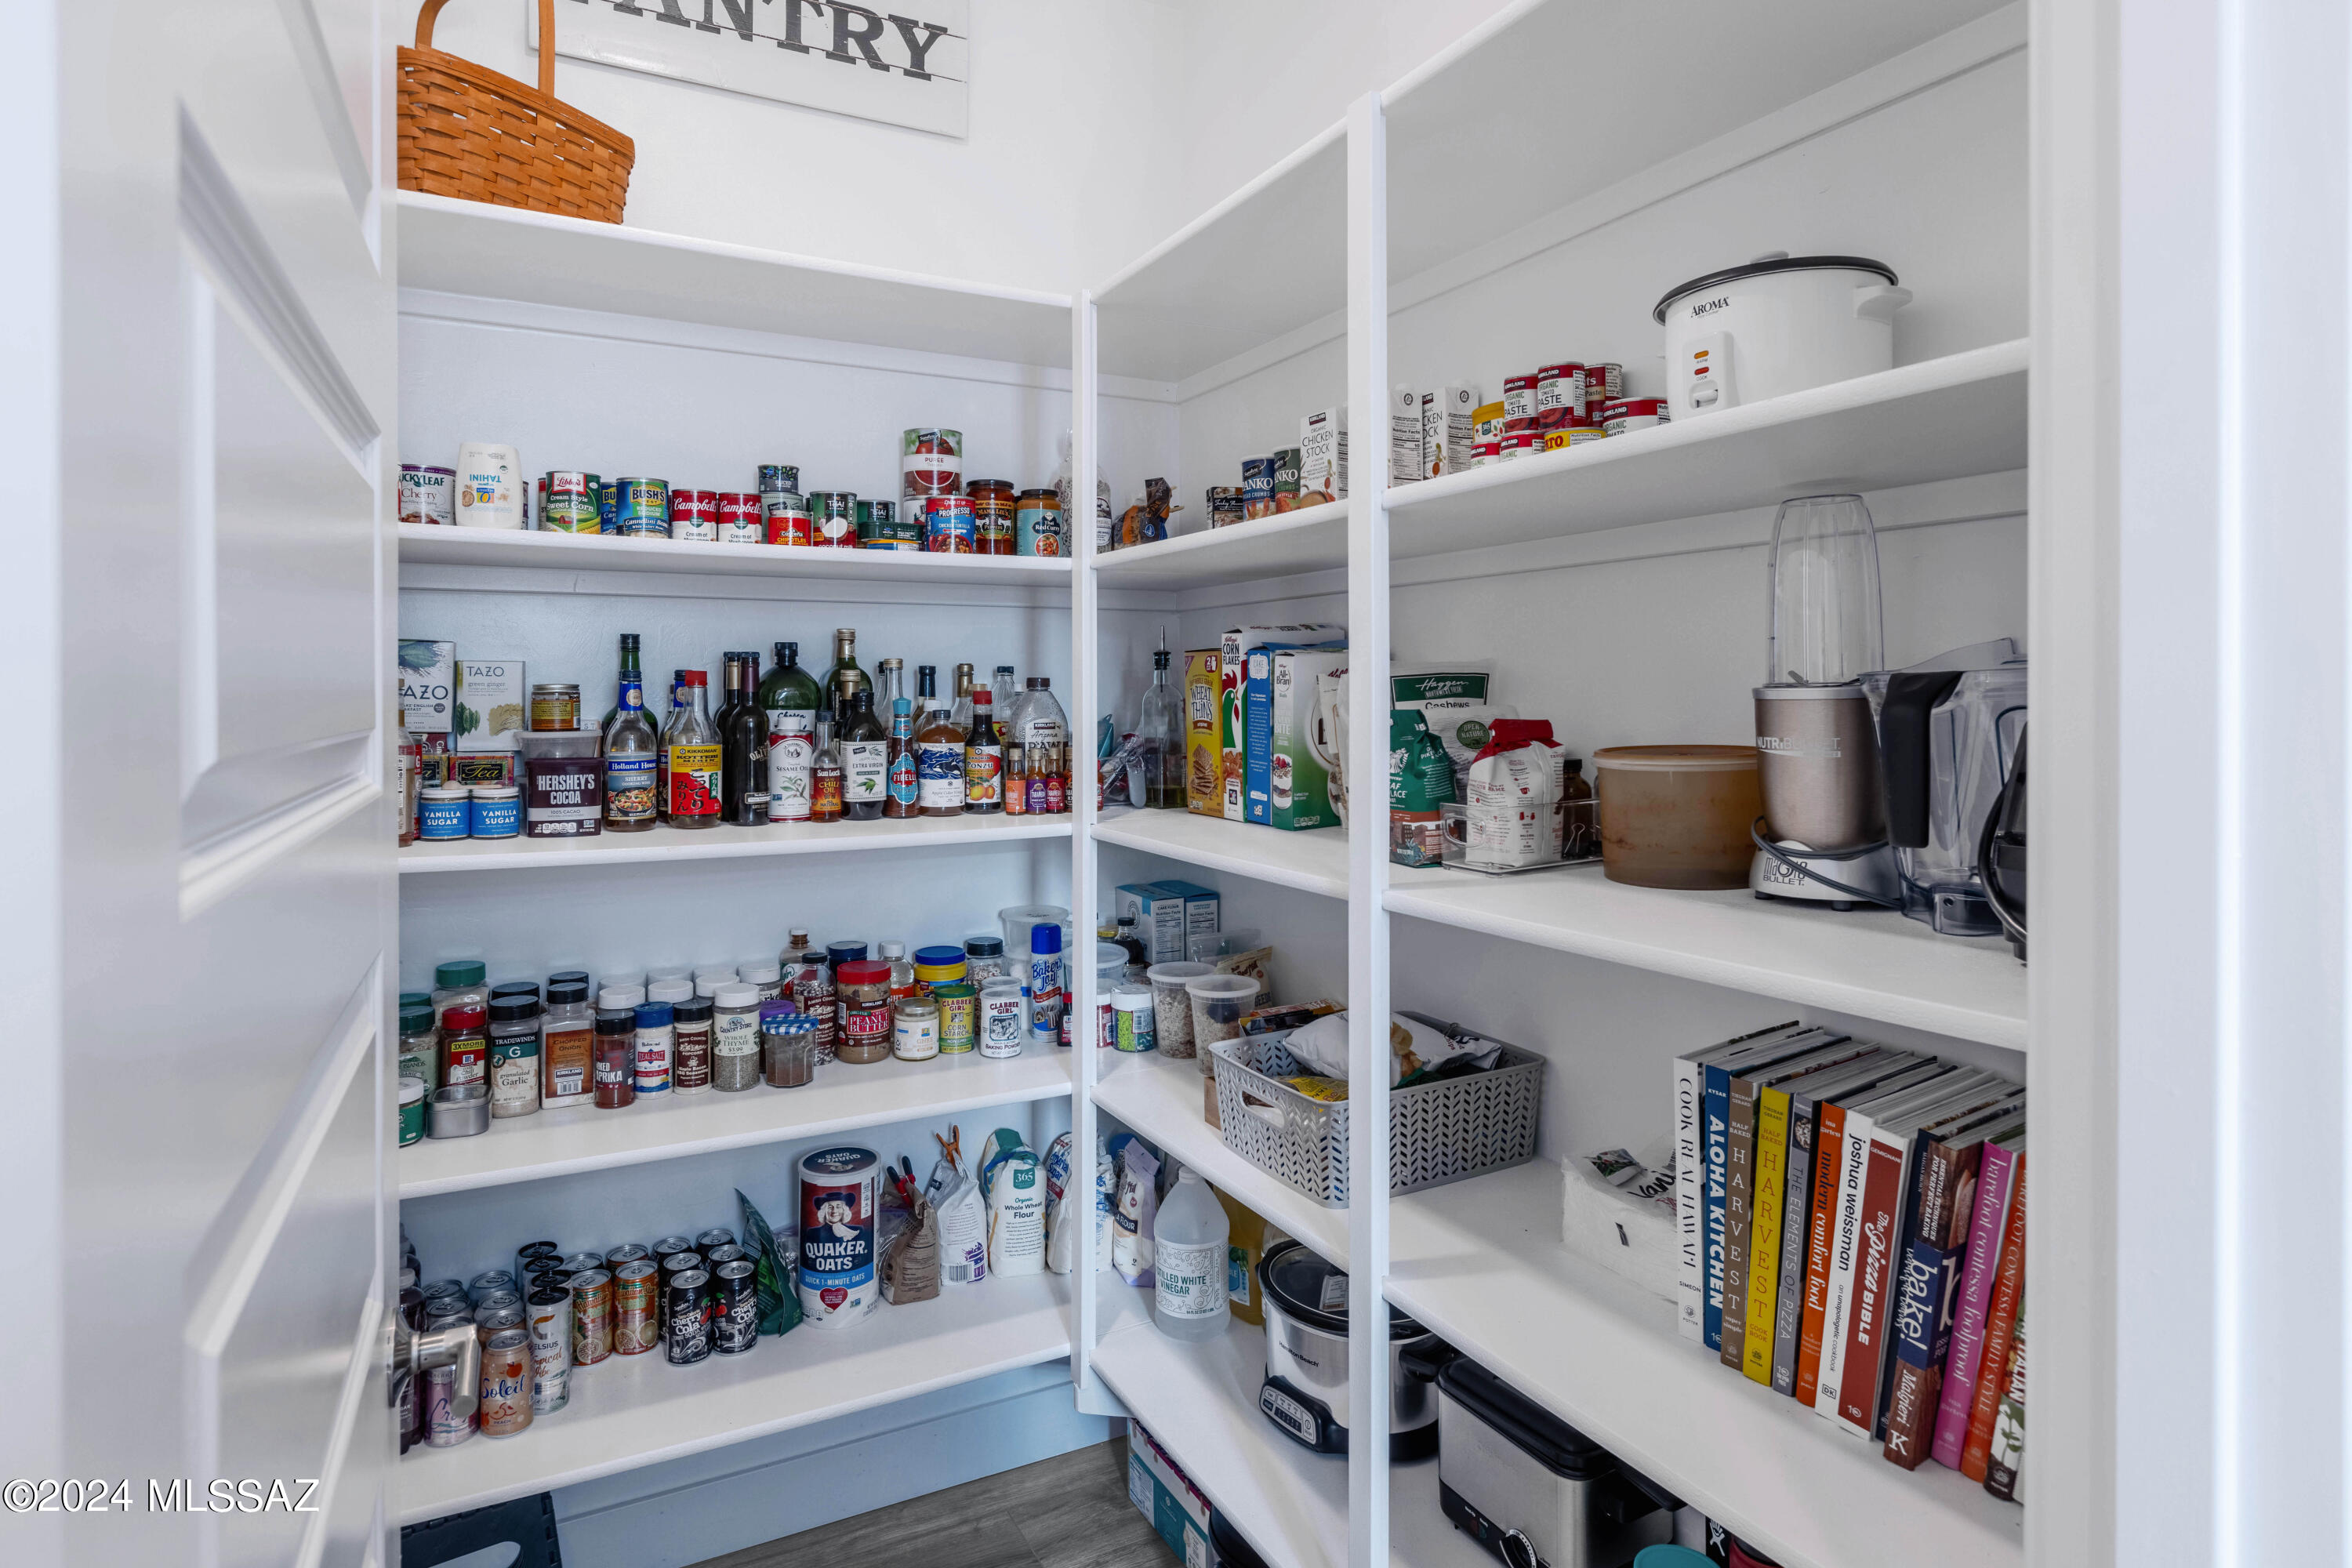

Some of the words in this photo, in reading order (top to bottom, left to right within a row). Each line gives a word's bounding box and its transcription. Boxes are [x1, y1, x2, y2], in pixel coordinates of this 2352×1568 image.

[1691, 297, 1729, 318] AROMA
[1538, 394, 1562, 406] PASTE
[1504, 405, 1528, 416] PASTE
[1310, 424, 1327, 434] ORGANIC
[1302, 429, 1333, 447] CHICKEN
[1306, 443, 1330, 459] STOCK
[423, 477, 445, 486] LEAF
[470, 474, 502, 484] TAHINI
[401, 488, 437, 501] Cherry
[632, 488, 665, 501] BUSH'S
[571, 502, 593, 512] Corn
[938, 508, 971, 517] PROGRESSO
[1223, 643, 1240, 655] CORN
[1223, 656, 1240, 665] FLAKES
[466, 666, 504, 677] TAZO
[1276, 677, 1290, 685] Bran
[1415, 677, 1469, 691] Haggen
[1190, 686, 1212, 702] WHEAT
[462, 764, 499, 779] Tea
[893, 771, 916, 782] FIRELLI
[538, 773, 595, 791] HERSHEY'S
[550, 791, 582, 805] COCOA
[677, 779, 688, 812] みりん
[1763, 874, 1805, 887] BULLET
[942, 999, 972, 1007] CLABBER
[989, 1001, 1019, 1011] CLABBER
[850, 1014, 890, 1025] PEANUT
[720, 1025, 739, 1033] COUNTRY
[739, 1022, 753, 1030] STORE
[850, 1022, 889, 1033] BUTTER
[452, 1042, 463, 1051] 3X
[495, 1035, 535, 1045] TRADEWINDS
[553, 1036, 588, 1045] CHOPPED
[510, 1046, 521, 1058] G
[499, 1070, 531, 1080] granulated
[502, 1077, 529, 1087] Garlic
[1708, 1087, 1727, 1098] KYSAR
[1731, 1091, 1752, 1102] TIEGHAN
[1679, 1077, 1693, 1131] COOK
[1731, 1098, 1751, 1107] GERARD
[1729, 1127, 1751, 1138] BAKED
[1731, 1120, 1749, 1131] HALF
[1763, 1127, 1781, 1138] HALF
[1760, 1134, 1783, 1147] BAKED
[1709, 1114, 1726, 1198] ALOHA
[1845, 1133, 1866, 1190] joshua
[1870, 1147, 1902, 1163] GEMIGNANI
[1015, 1171, 1033, 1183] 365
[1791, 1167, 1803, 1194] THE
[1817, 1150, 1835, 1210] modern
[1936, 1159, 1947, 1197] ESSENTIAL
[1926, 1171, 1938, 1208] PERFECT
[1978, 1156, 2008, 1229] barefoot
[1014, 1196, 1033, 1205] Organic
[1014, 1210, 1035, 1219] Flour
[1876, 1210, 1890, 1232] The
[1929, 1196, 1942, 1242] TECHNIQUES
[1120, 1216, 1136, 1231] FLOUR
[1922, 1207, 1933, 1239] BAKING
[1784, 1196, 1802, 1272] ELEMENTS
[1838, 1192, 1858, 1272] weissman
[805, 1240, 865, 1258] QUAKER
[1811, 1212, 1829, 1273] comfort
[1709, 1204, 1725, 1309] KITCHEN
[1864, 1222, 1887, 1292] Pizza
[815, 1257, 853, 1271] OATS
[1965, 1231, 1989, 1303] contessa
[805, 1275, 821, 1284] QUICK
[821, 1276, 851, 1287] 1-MINUTE
[851, 1272, 865, 1283] OATS
[1160, 1278, 1190, 1295] VINEGAR
[1180, 1276, 1207, 1285] WHITE
[1679, 1280, 1701, 1293] SIMEON
[1784, 1275, 1795, 1296] OF
[1998, 1245, 2020, 1320] CONTESSA
[1808, 1275, 1827, 1312] food
[1900, 1258, 1938, 1351] bake!
[670, 1312, 702, 1327] Cherry
[1682, 1317, 1699, 1326] POTTER
[1780, 1298, 1795, 1339] PIZZA
[1833, 1294, 1844, 1340] unapologetic
[1858, 1290, 1875, 1346] BIBLE
[675, 1322, 701, 1335] Cola
[684, 1329, 700, 1338] SODA
[1749, 1323, 1769, 1336] COOK
[1953, 1303, 1982, 1388] foolproof
[1986, 1320, 2007, 1372] FAMILY
[1299, 1355, 1319, 1367] Beach
[1831, 1338, 1839, 1373] cookbook
[481, 1375, 526, 1399] Soleil
[1823, 1387, 1835, 1397] DK
[1896, 1369, 1917, 1428] Malgieri
[1978, 1374, 1996, 1417] STYLE
